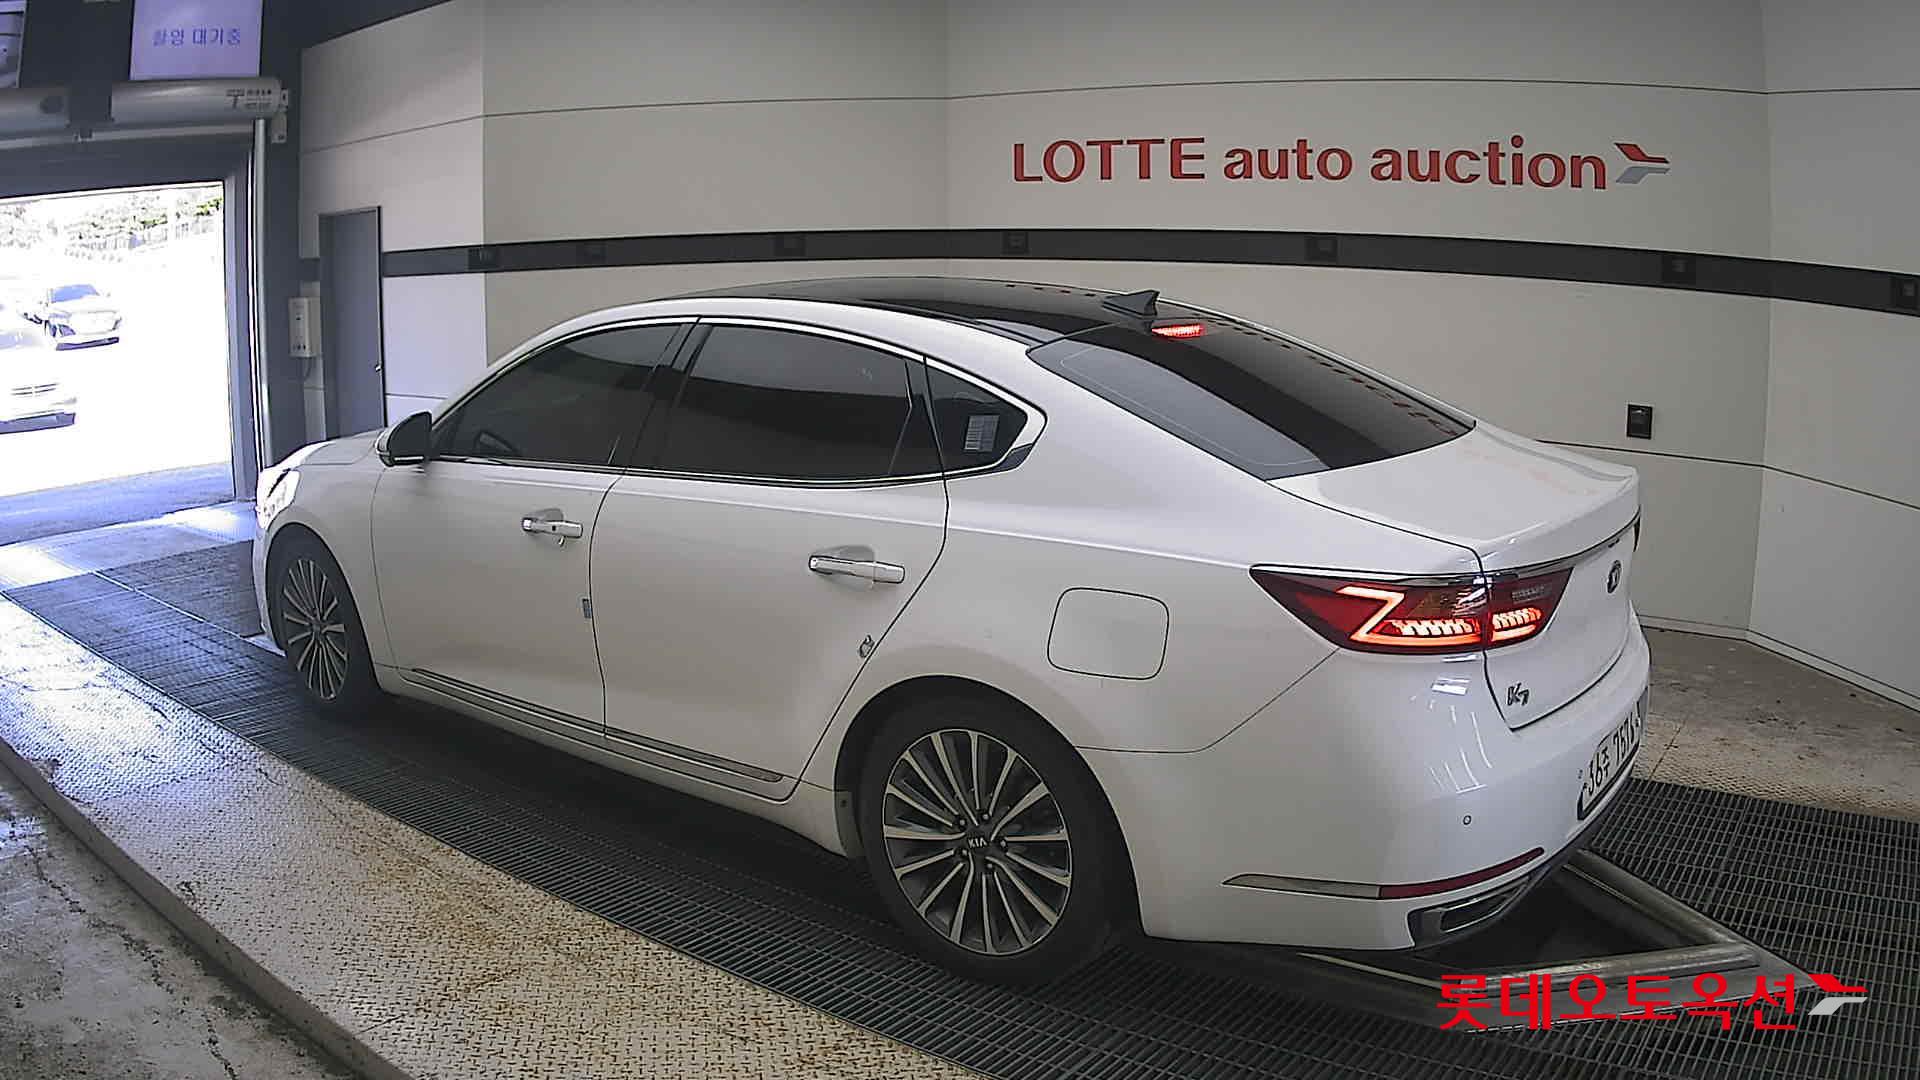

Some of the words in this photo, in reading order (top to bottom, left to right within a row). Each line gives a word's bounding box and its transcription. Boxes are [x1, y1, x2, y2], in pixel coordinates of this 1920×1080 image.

[1013, 137, 1206, 184] LOTTE
[1223, 138, 1353, 182] auto
[1370, 134, 1607, 190] auction
